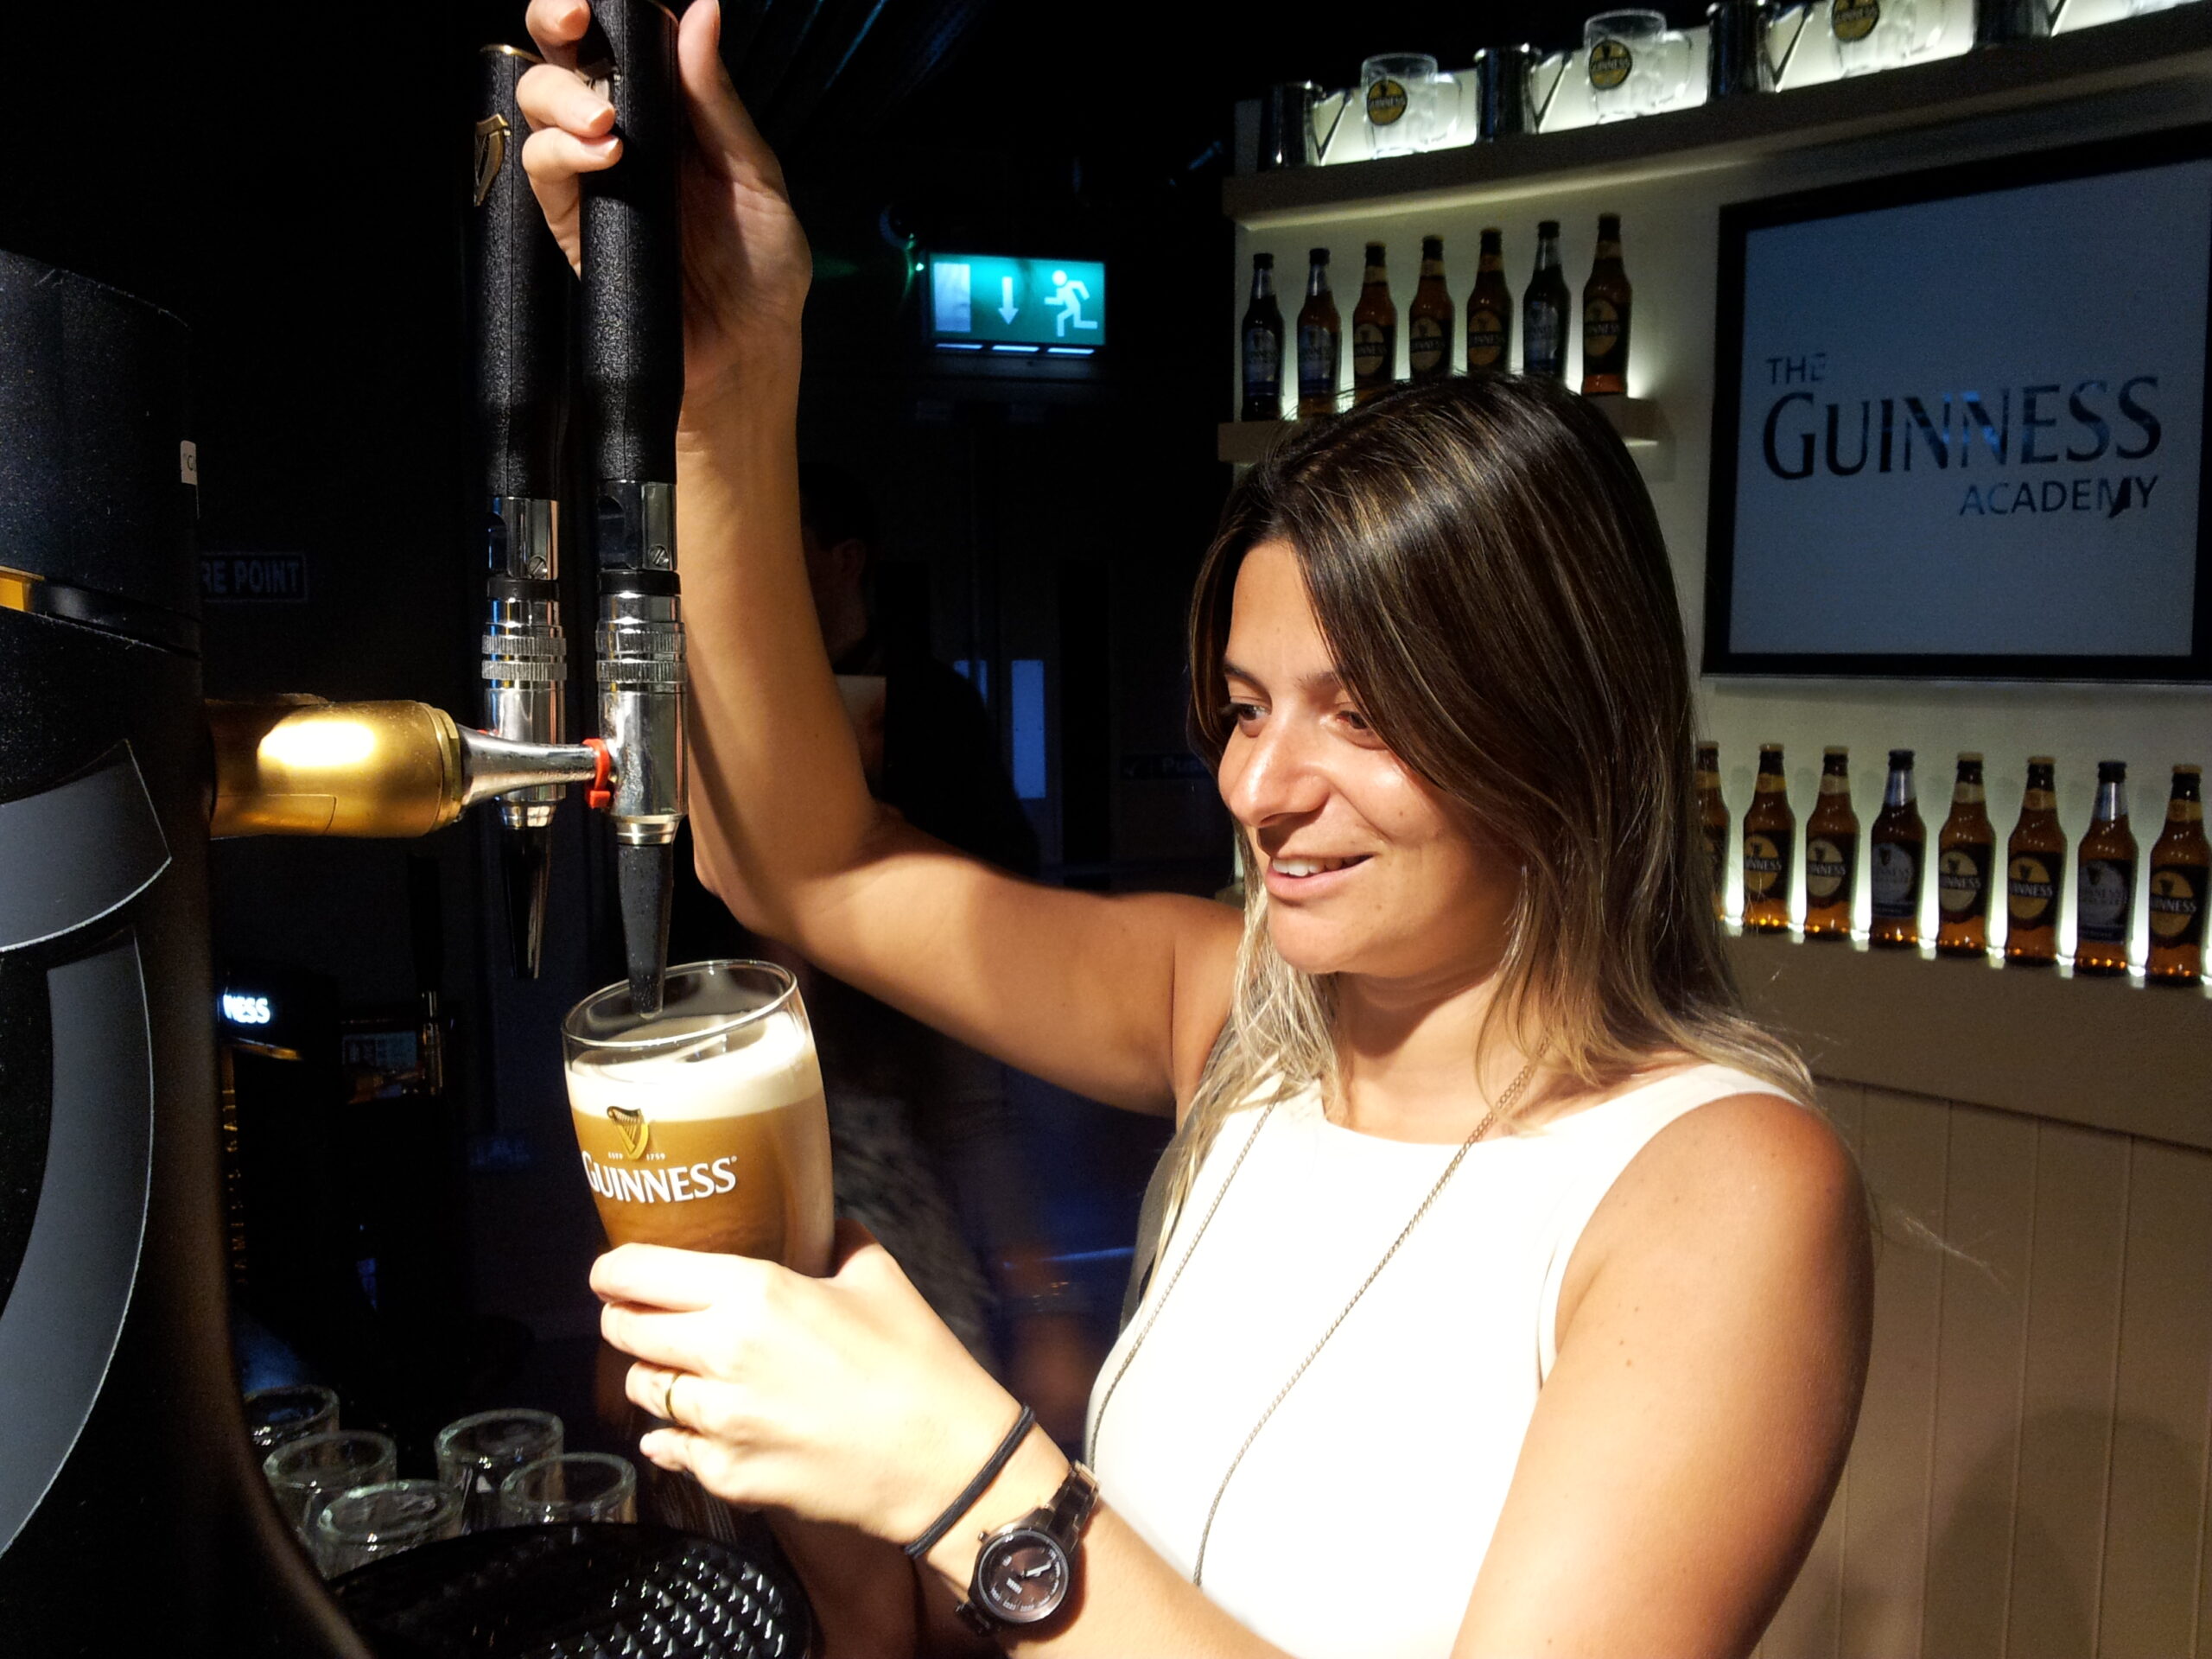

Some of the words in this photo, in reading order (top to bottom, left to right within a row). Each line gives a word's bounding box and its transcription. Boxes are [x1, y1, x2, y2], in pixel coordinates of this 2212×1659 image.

[1766, 353, 1827, 385] THE
[1763, 376, 2162, 480] GUINNESS
[1961, 475, 2159, 518] ACADEMY
[233, 560, 300, 594] POINT
[645, 1152, 666, 1161] 1759
[582, 1150, 737, 1204] GUINNESS
